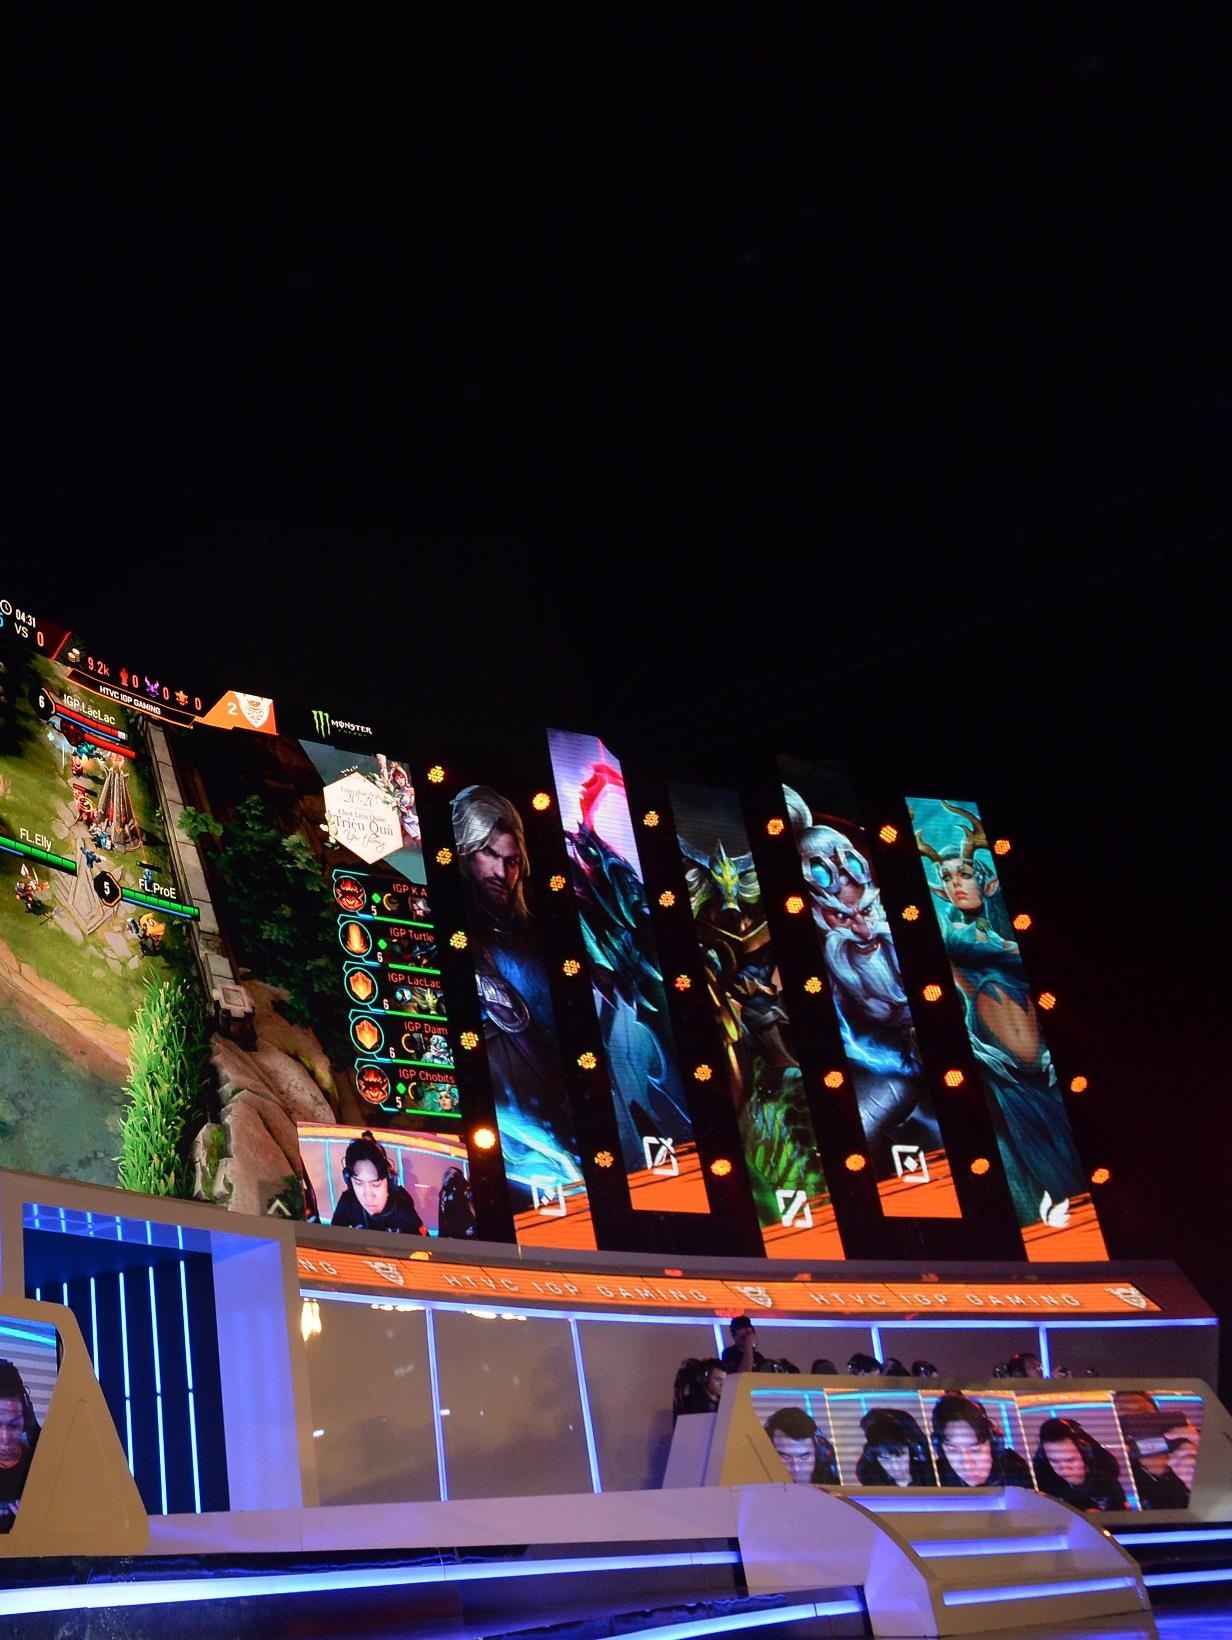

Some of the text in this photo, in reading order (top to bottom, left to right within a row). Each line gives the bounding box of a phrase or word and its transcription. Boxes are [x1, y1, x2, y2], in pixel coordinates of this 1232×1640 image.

[16, 609, 36, 628] 04:31
[14, 622, 28, 638] VS
[37, 631, 44, 647] 0
[87, 657, 201, 711] 9.2k 0 0 0
[39, 695, 45, 708] 6
[99, 685, 161, 716] HTVC IGP GAMING
[226, 701, 238, 717] 2
[63, 694, 116, 725] IGP.LacLac
[20, 828, 52, 852] FL.Elly
[103, 878, 176, 899] 5 FL.ProE
[371, 905, 377, 916] 5
[377, 951, 383, 963] 6
[383, 999, 389, 1009] 6
[389, 1047, 395, 1058] 6
[396, 1096, 402, 1109] 5
[443, 1274, 708, 1302] HTVC IGP GAMING
[809, 1291, 1081, 1307] HTVC IGP GAMING
